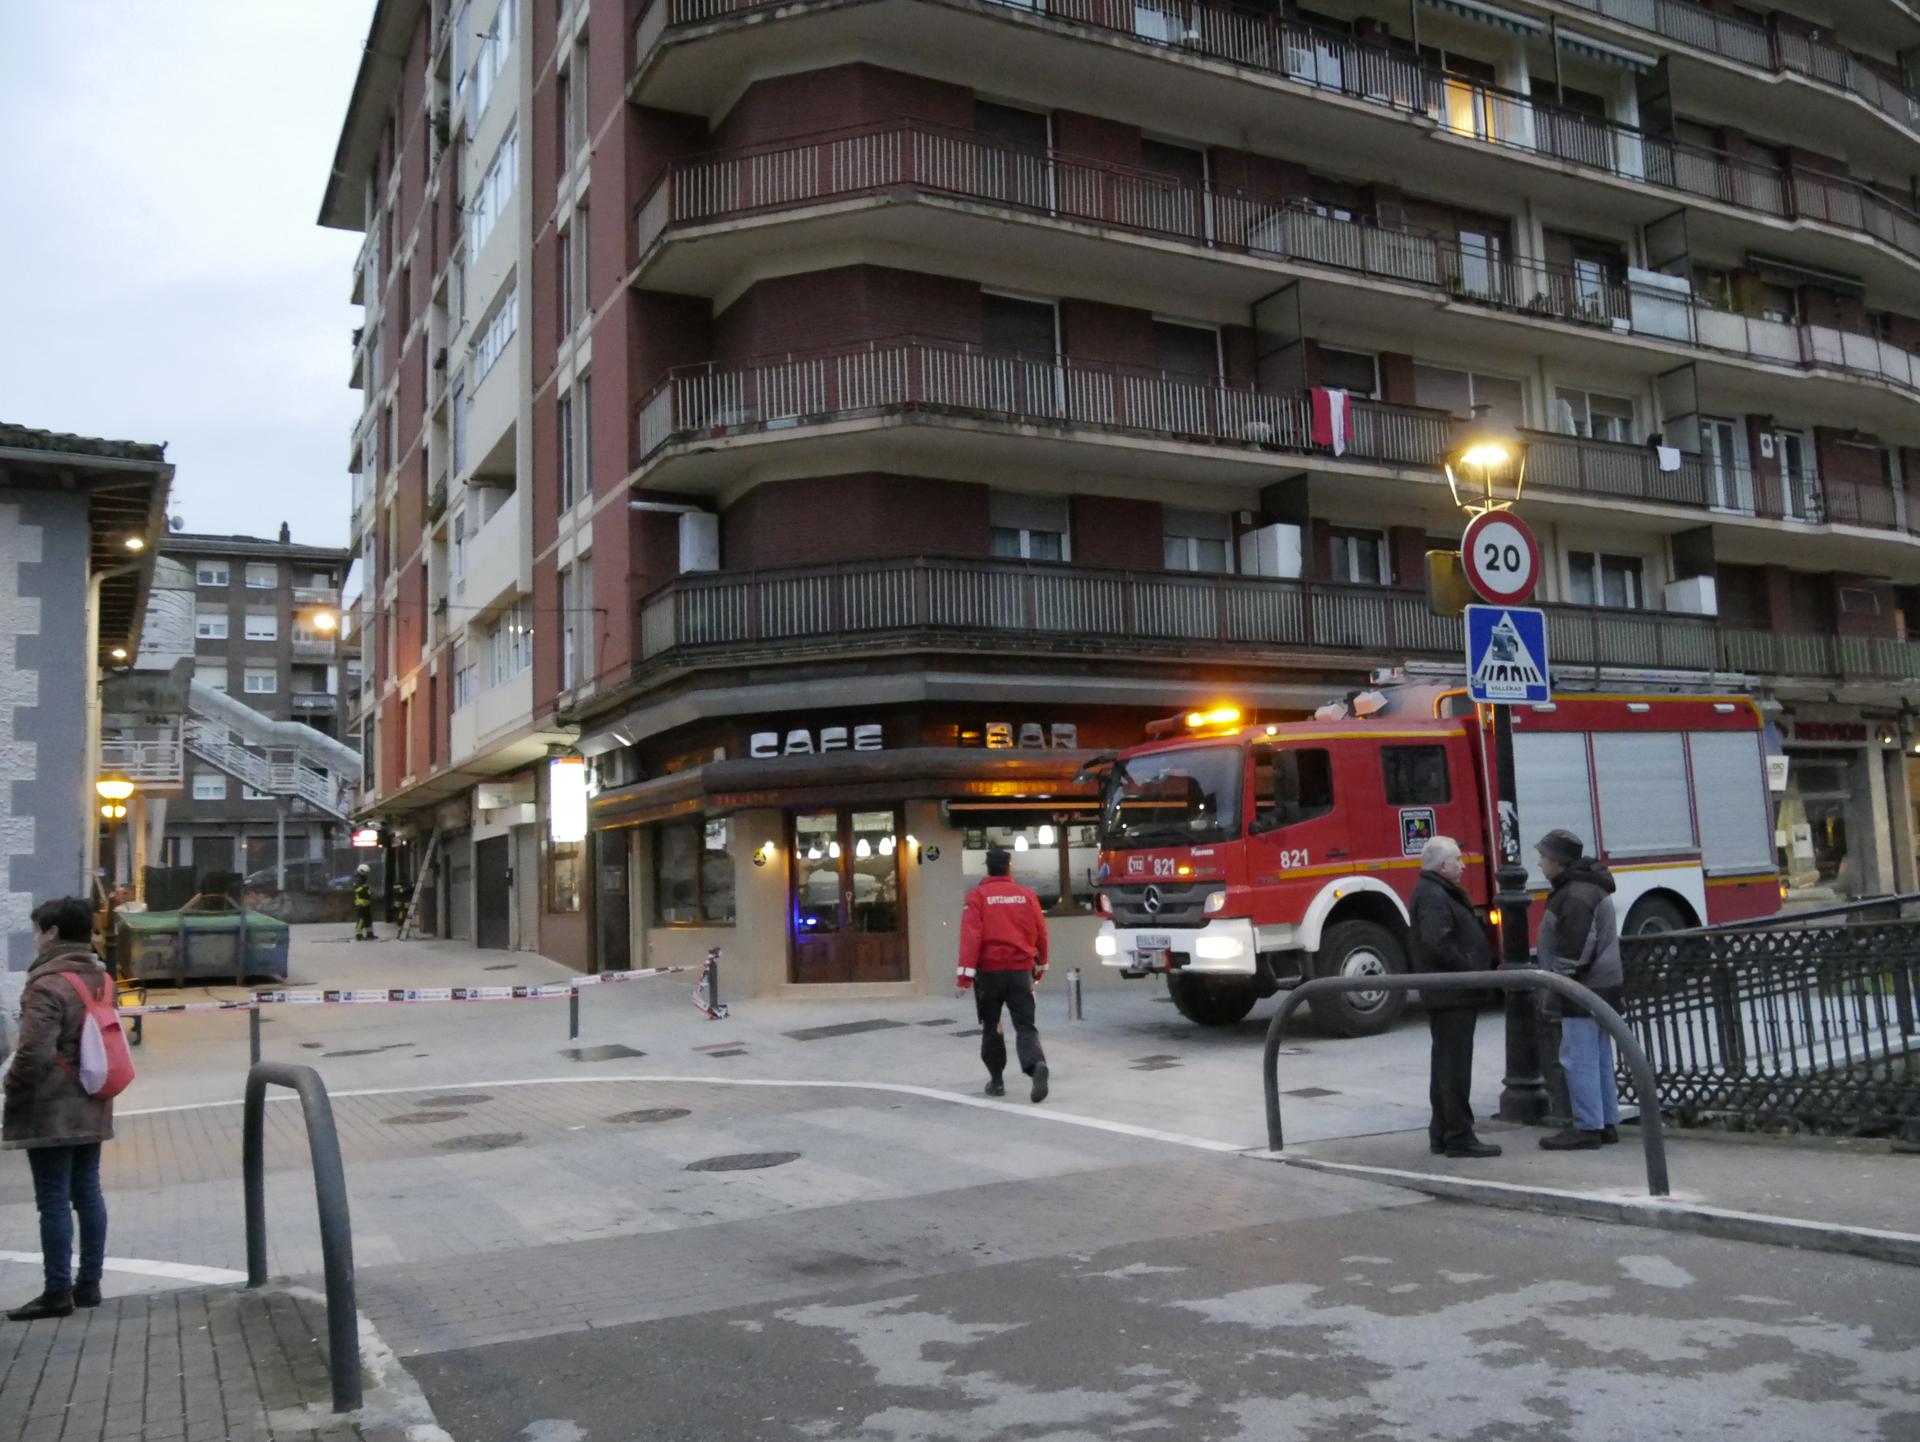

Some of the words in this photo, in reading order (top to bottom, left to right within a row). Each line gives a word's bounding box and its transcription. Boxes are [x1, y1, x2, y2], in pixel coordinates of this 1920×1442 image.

[1484, 543, 1520, 573] 20
[750, 723, 883, 758] CAFE
[986, 722, 1078, 749] BAR
[1153, 858, 1175, 876] 821
[1279, 849, 1309, 869] 821
